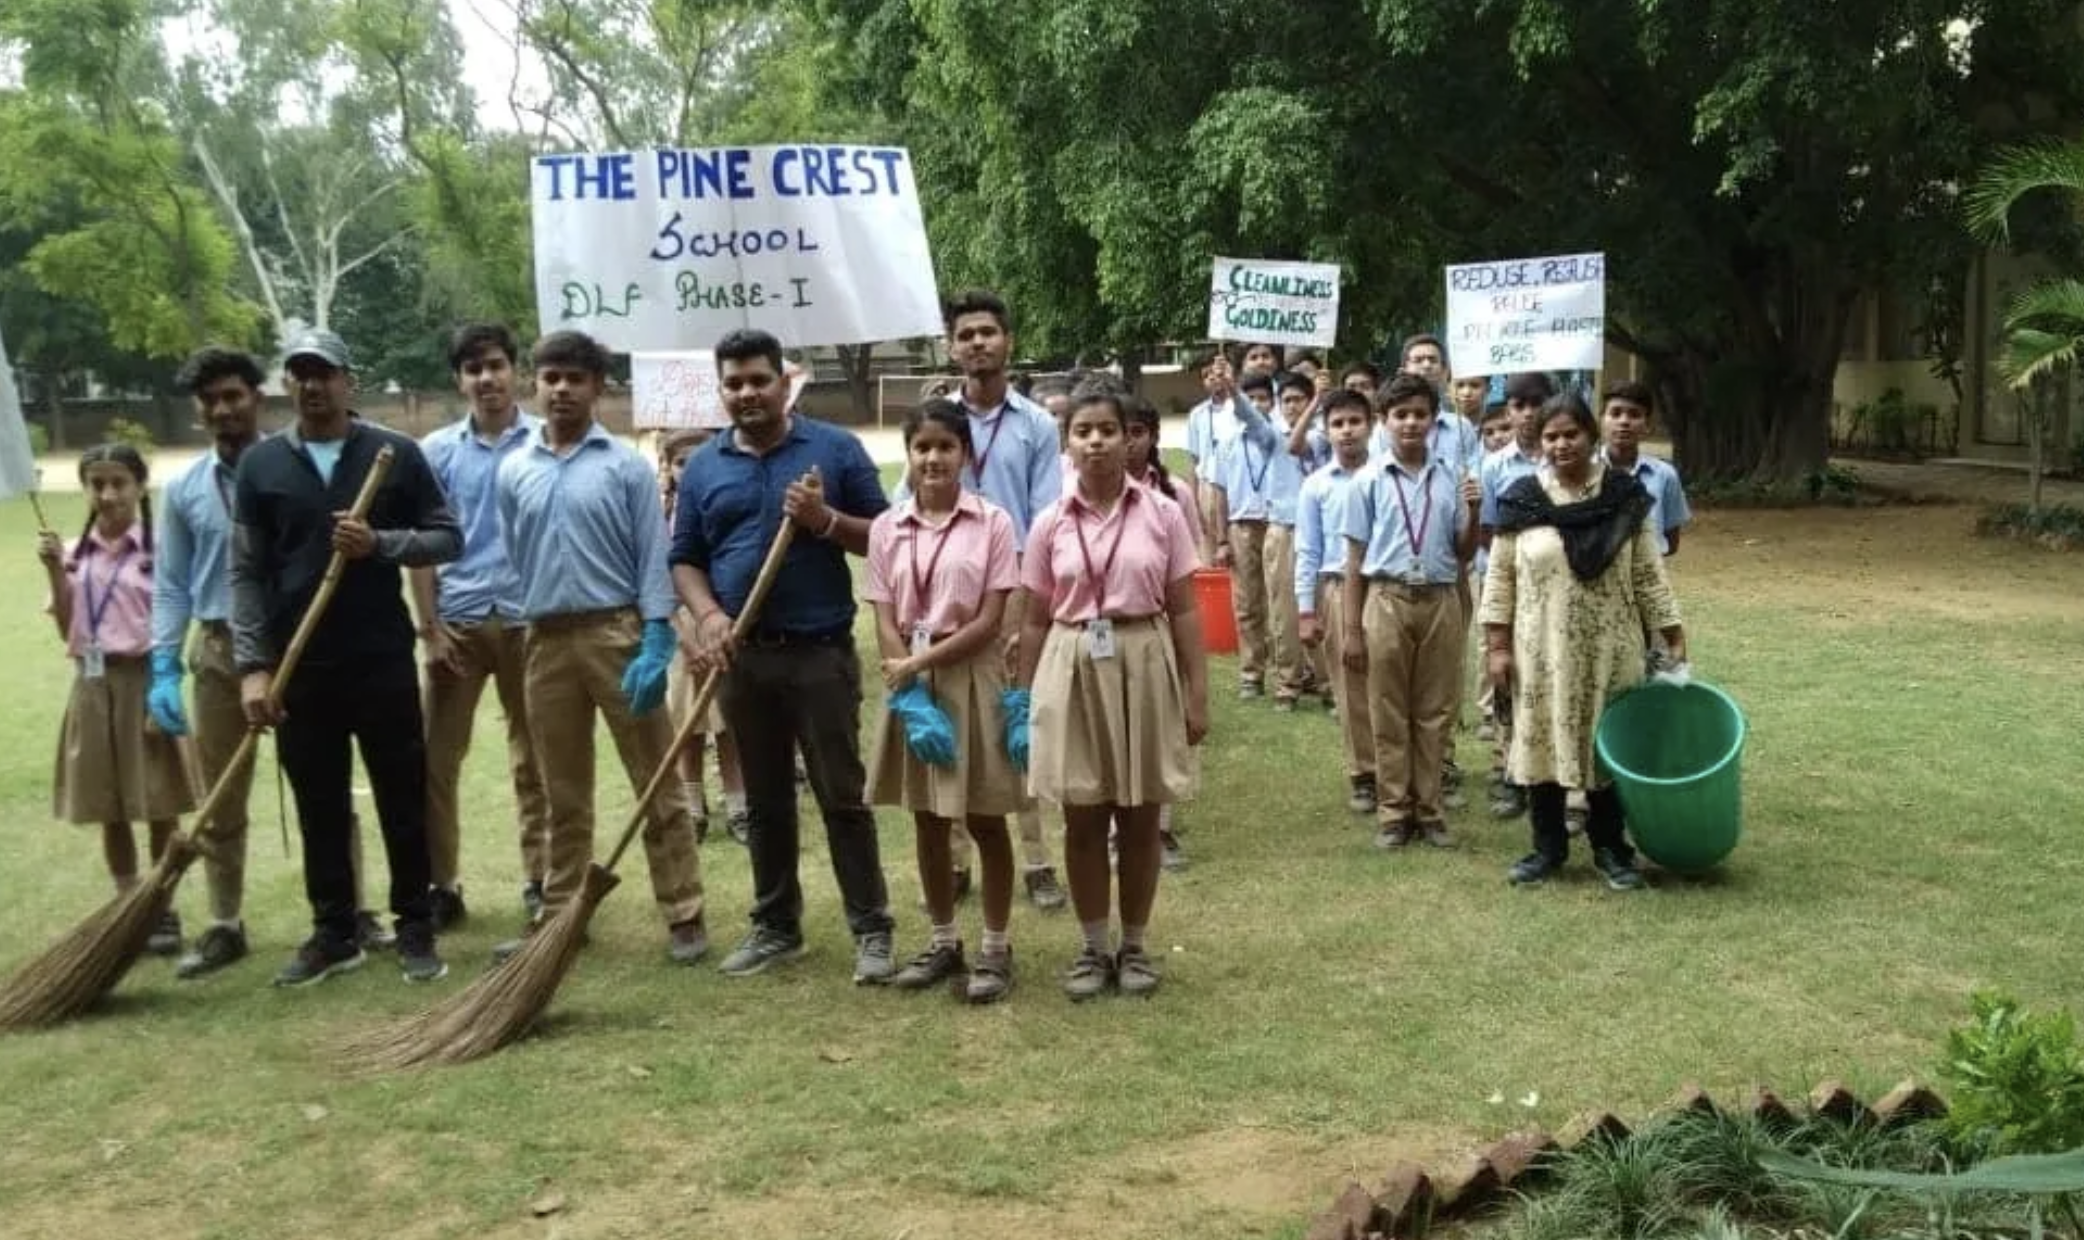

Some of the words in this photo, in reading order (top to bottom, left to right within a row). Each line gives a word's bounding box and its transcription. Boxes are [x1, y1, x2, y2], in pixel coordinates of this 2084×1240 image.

[537, 154, 636, 200] THE
[657, 149, 754, 198] PINE
[772, 148, 903, 196] CREST
[650, 211, 819, 260] SCHOOL
[560, 281, 643, 321] DLF
[1229, 264, 1333, 299] CLEANLINESS
[1225, 304, 1318, 334] GOLDINESS
